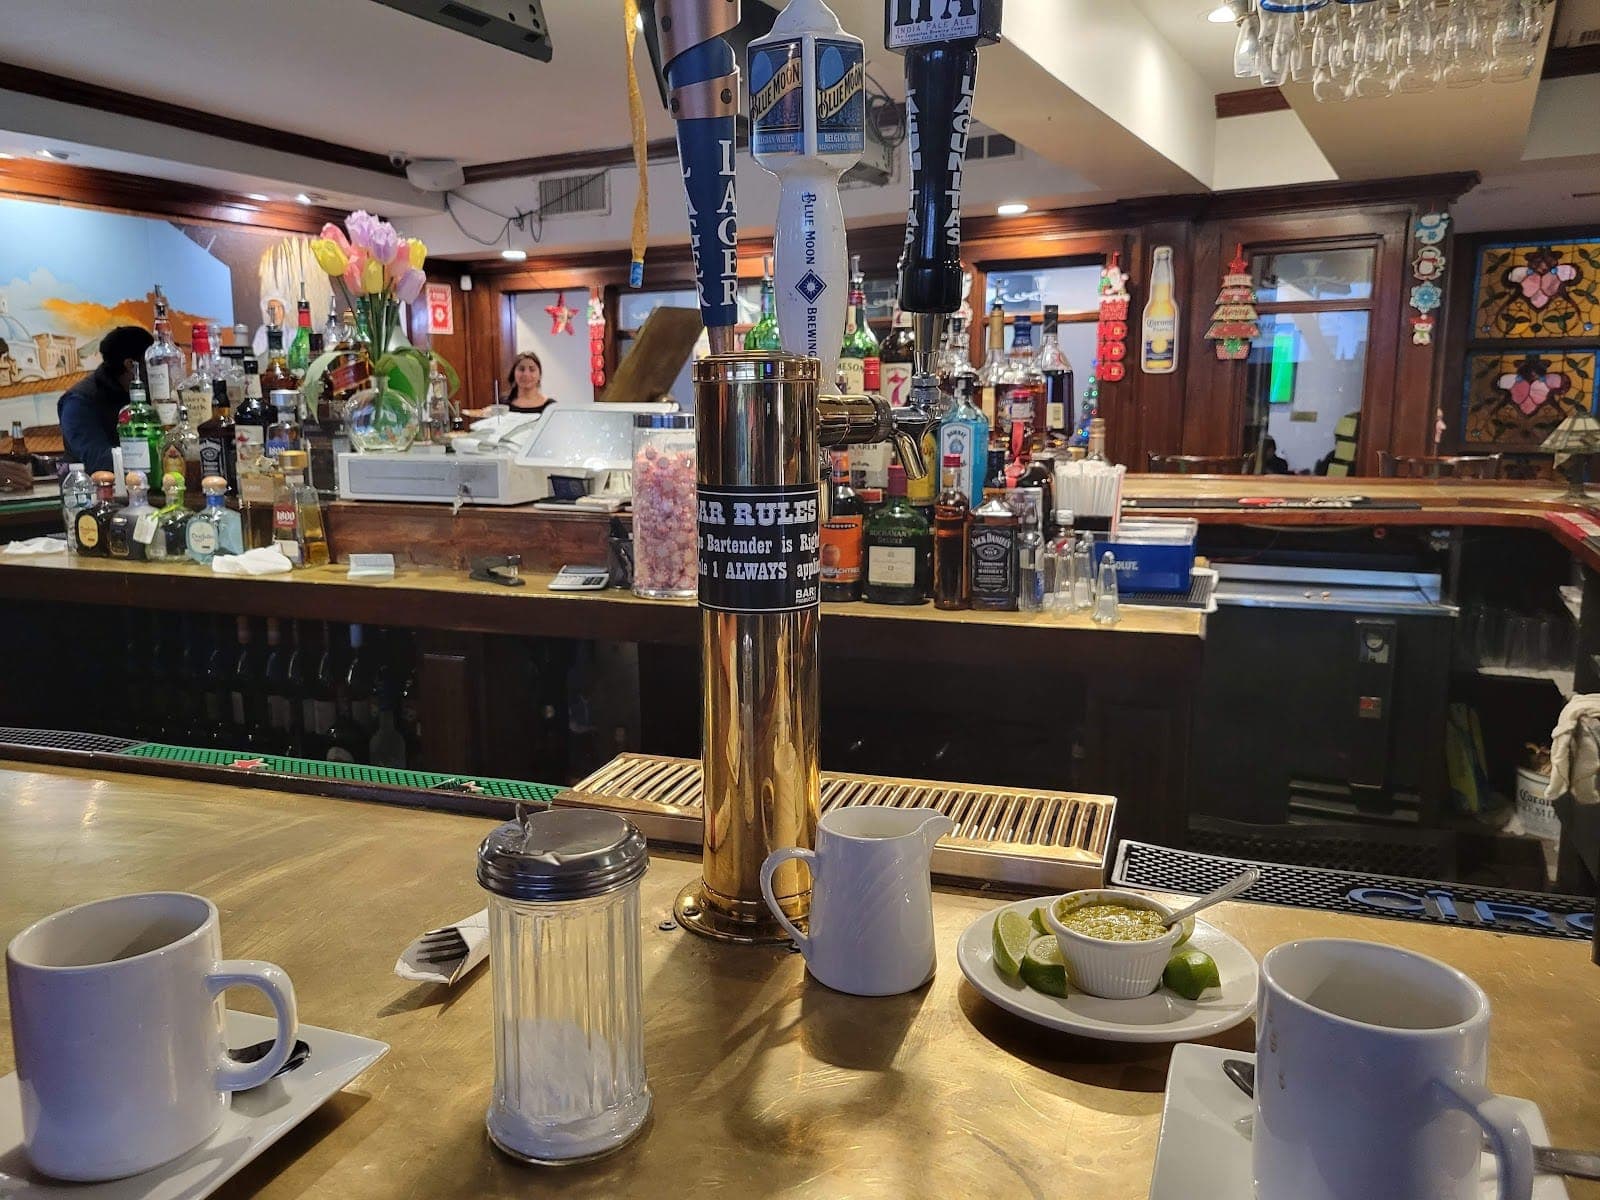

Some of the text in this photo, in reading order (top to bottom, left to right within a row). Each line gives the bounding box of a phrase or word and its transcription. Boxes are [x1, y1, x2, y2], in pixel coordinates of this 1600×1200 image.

[896, 17, 972, 35] INDIA PALE ALE
[751, 63, 800, 121] BLUE MOON
[818, 84, 845, 121] BLUE
[777, 134, 795, 143] WHITE
[824, 132, 847, 143] BELGIAN
[944, 75, 974, 246] LAGUNITAS
[716, 140, 738, 307] LAGER
[801, 191, 817, 265] BLUE MOON
[807, 307, 818, 358] BREWING
[887, 371, 909, 406] 7
[276, 510, 295, 521] 1800
[699, 499, 817, 526] AR RULES
[707, 533, 772, 554] Bartender
[782, 536, 793, 553] is
[725, 562, 788, 580] ALWAYS
